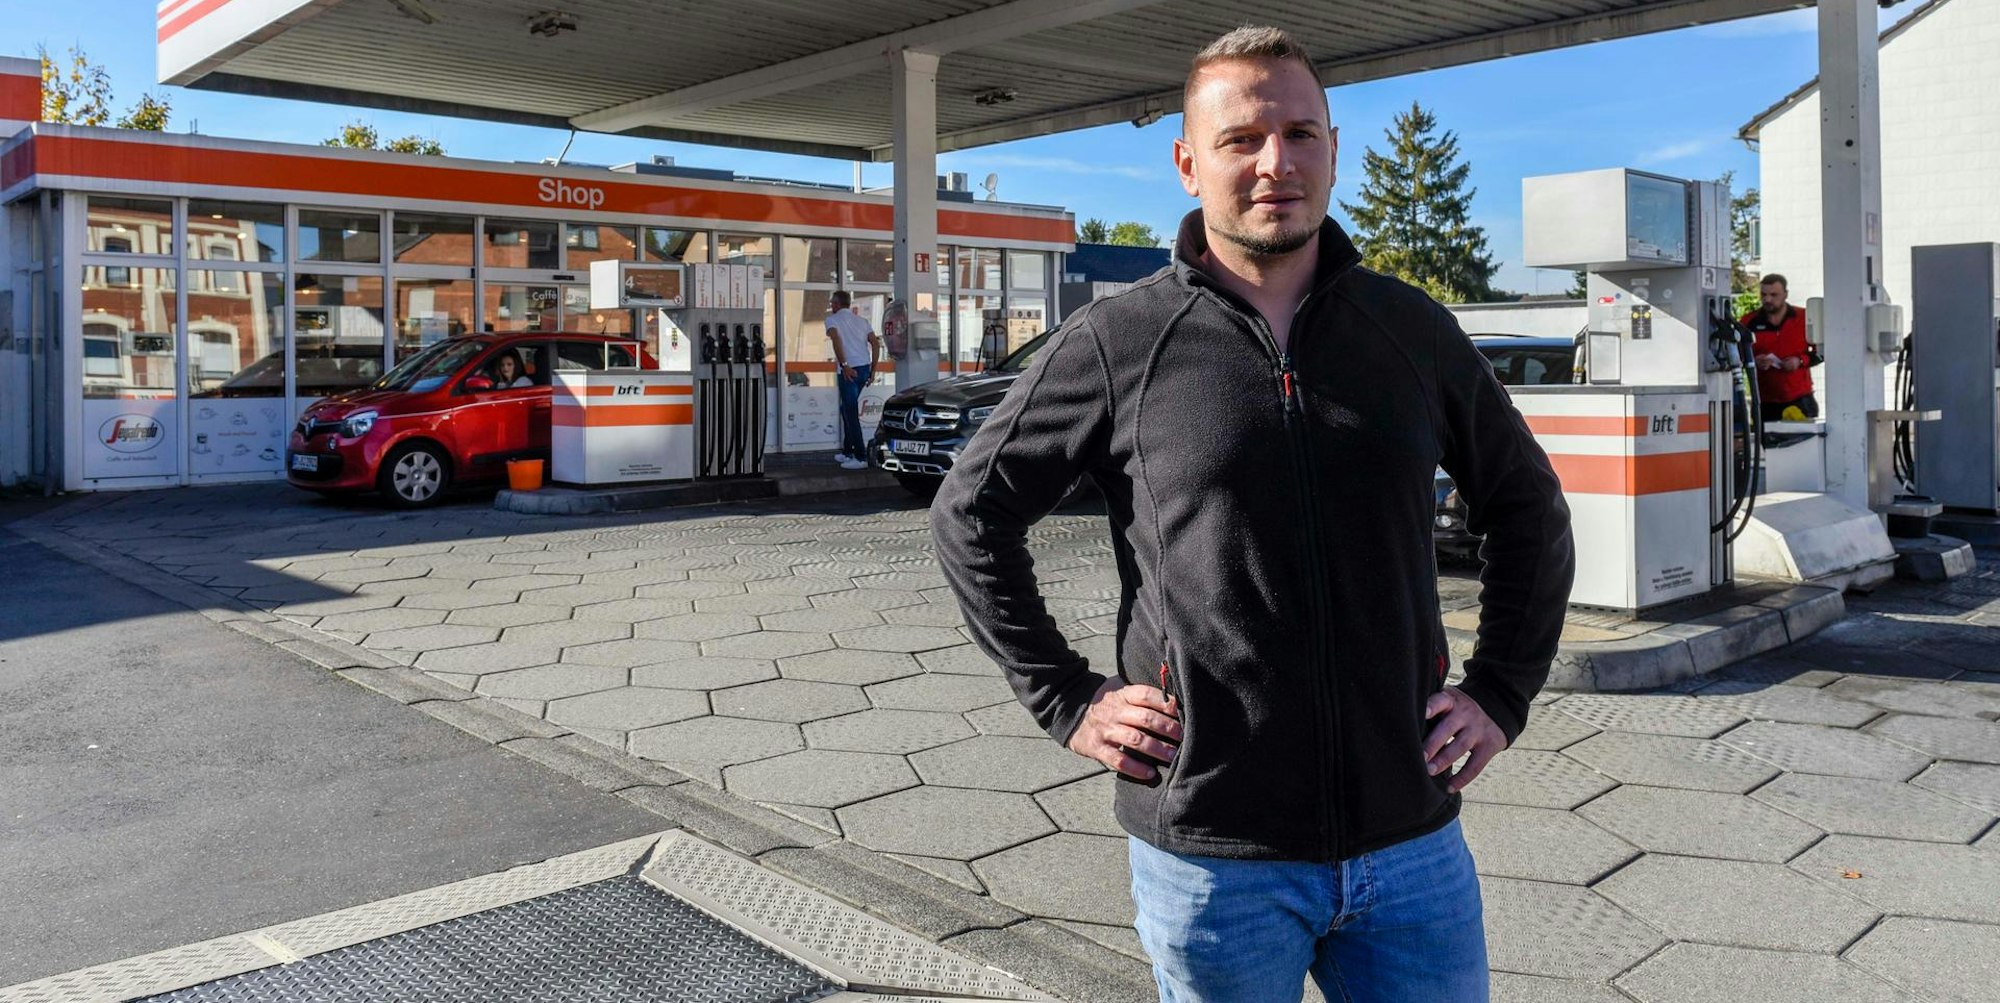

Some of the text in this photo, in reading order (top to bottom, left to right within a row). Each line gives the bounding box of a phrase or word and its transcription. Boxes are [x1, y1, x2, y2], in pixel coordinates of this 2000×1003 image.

[538, 178, 604, 210] Shop
[625, 275, 635, 289] 4
[618, 385, 640, 395] bft
[1652, 415, 1674, 432] bft
[917, 443, 926, 454] 77
